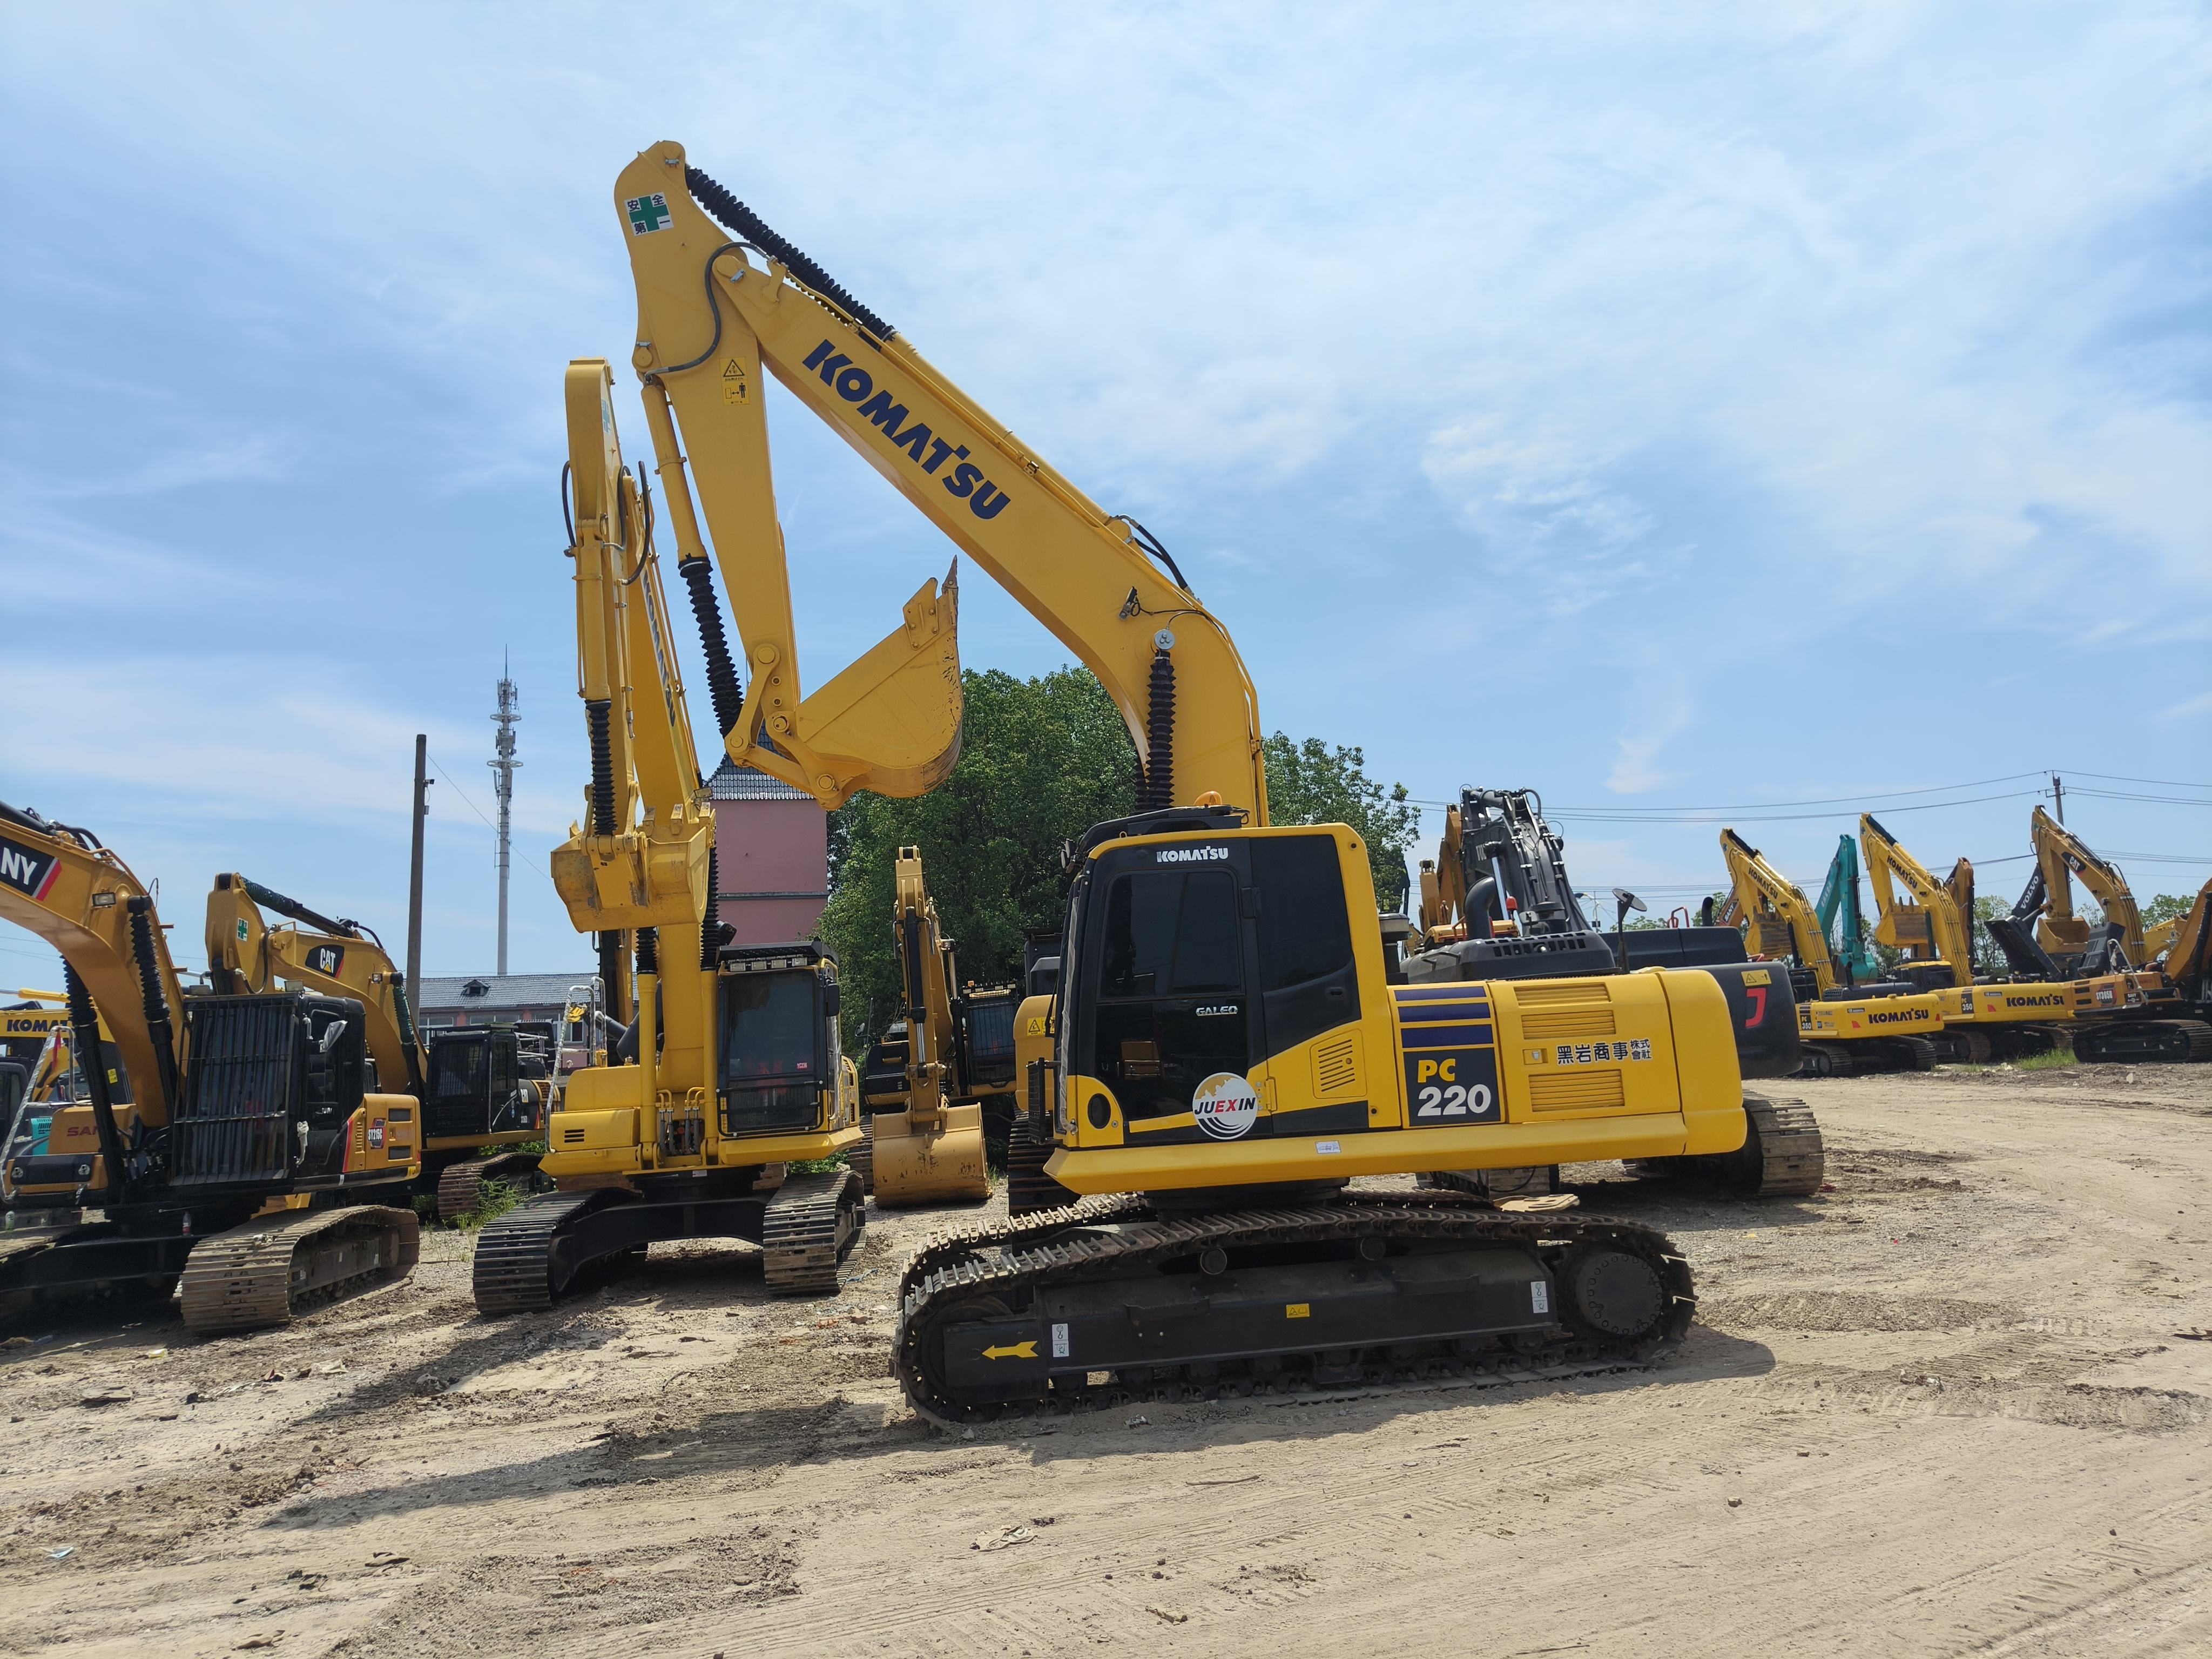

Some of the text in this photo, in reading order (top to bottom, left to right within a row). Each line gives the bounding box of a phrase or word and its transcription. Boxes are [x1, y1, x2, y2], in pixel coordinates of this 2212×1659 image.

[802, 339, 1011, 520] KOMATSU
[1, 847, 37, 885] NY
[1156, 846, 1229, 862] KOMATSU
[2069, 856, 2080, 871] CAT
[1748, 867, 1778, 899] KOMATSU
[1887, 855, 1918, 889] KOMATSU
[2020, 875, 2039, 909] VOLVO
[320, 948, 336, 974] CAT
[1196, 1006, 1238, 1016] GALEO
[1868, 1008, 1929, 1023] KOMATSU
[1630, 1038, 1650, 1049] 株式
[1417, 1058, 1455, 1083] PC
[1194, 1097, 1256, 1115] JUEXIN
[1417, 1084, 1491, 1116] 220
